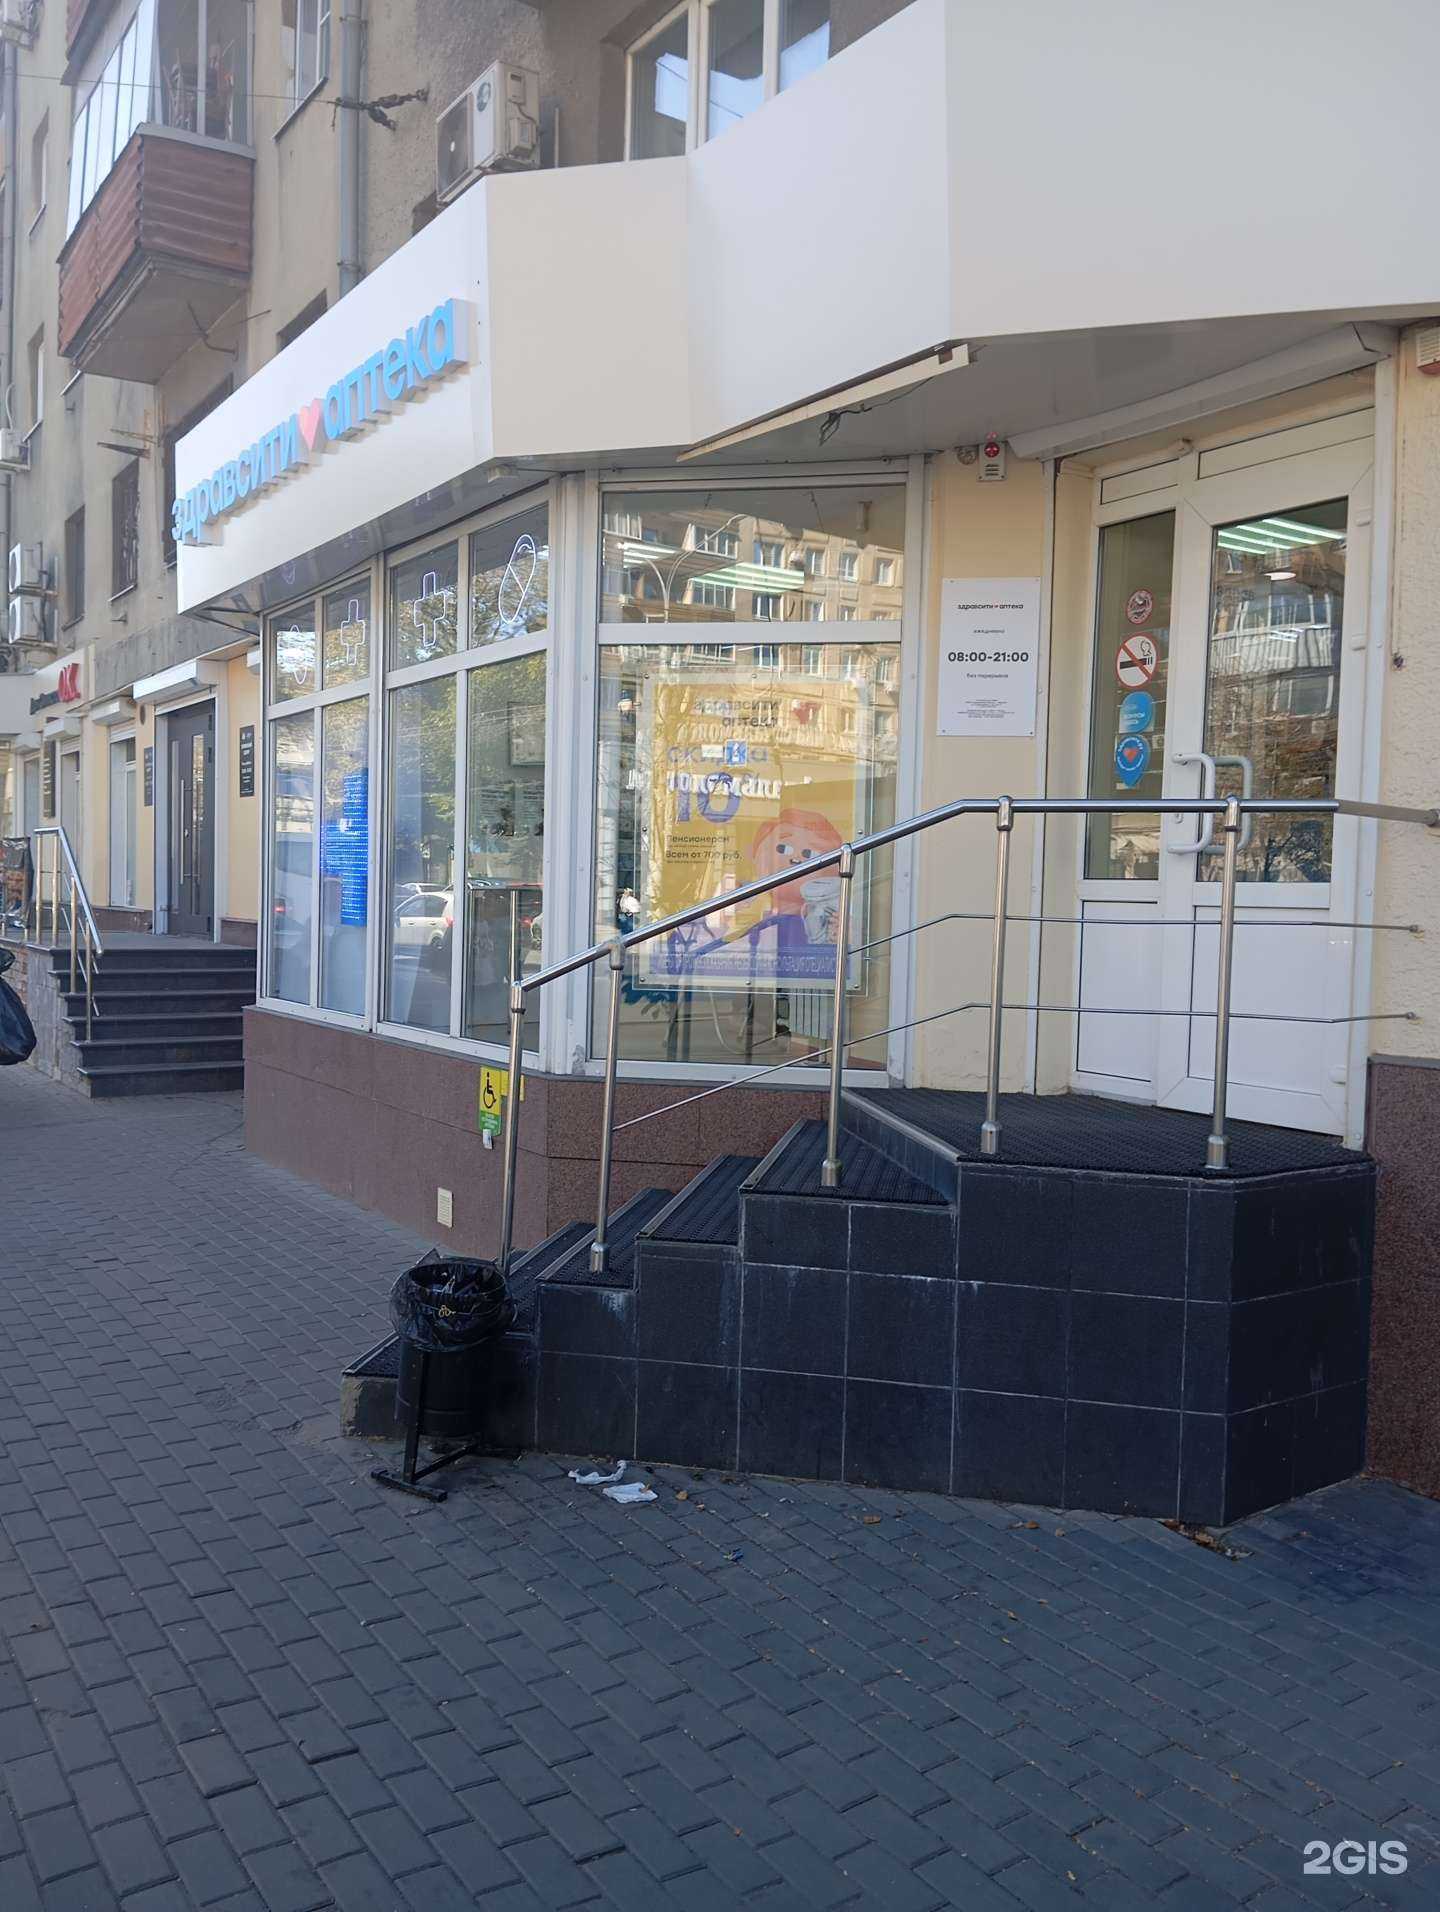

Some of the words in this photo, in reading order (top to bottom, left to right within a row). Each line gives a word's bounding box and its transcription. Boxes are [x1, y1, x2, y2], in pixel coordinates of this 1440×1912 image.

[172, 413, 301, 542] здравсити
[323, 298, 458, 441] аптека
[958, 603, 993, 611] здравсити
[948, 651, 1029, 662] 08:00-21:00
